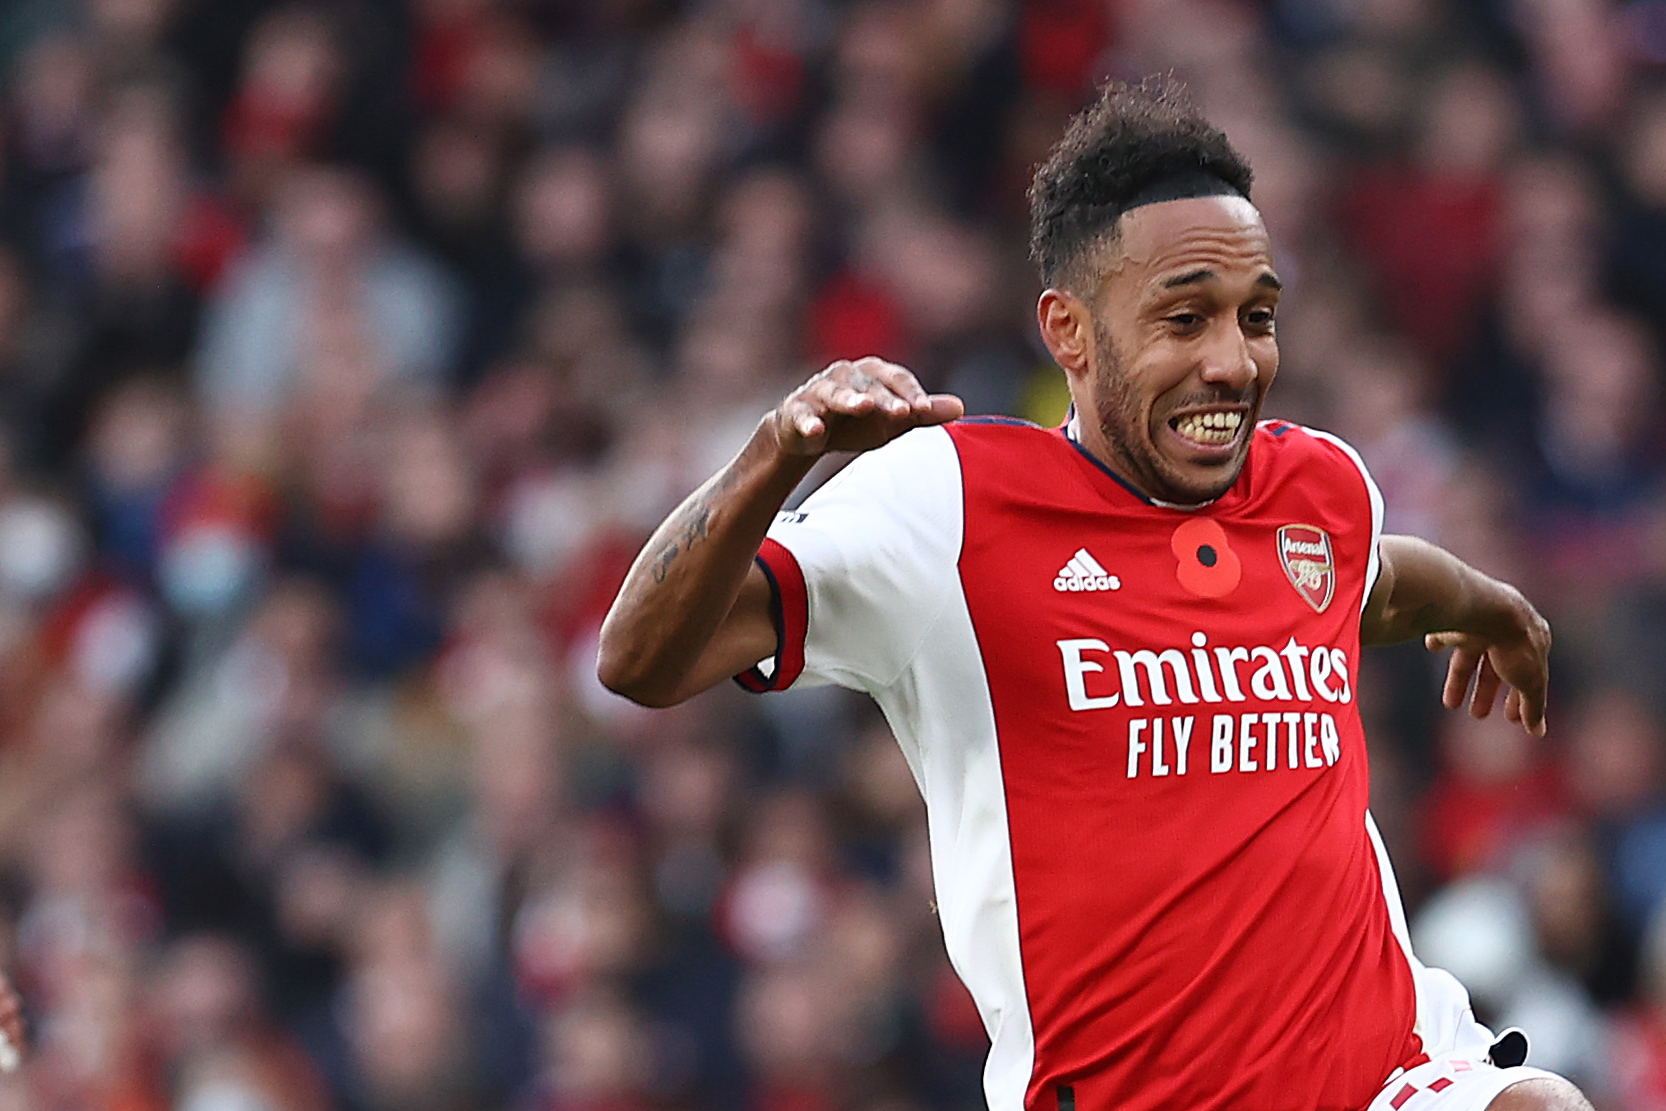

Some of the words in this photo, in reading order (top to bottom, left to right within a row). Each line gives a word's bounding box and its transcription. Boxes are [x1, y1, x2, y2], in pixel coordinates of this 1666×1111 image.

[1285, 538, 1326, 555] Arsenal
[1053, 575, 1121, 592] adidas
[1056, 631, 1352, 711] Emirates
[1127, 715, 1194, 778] FLY
[1211, 712, 1340, 773] BETTER
